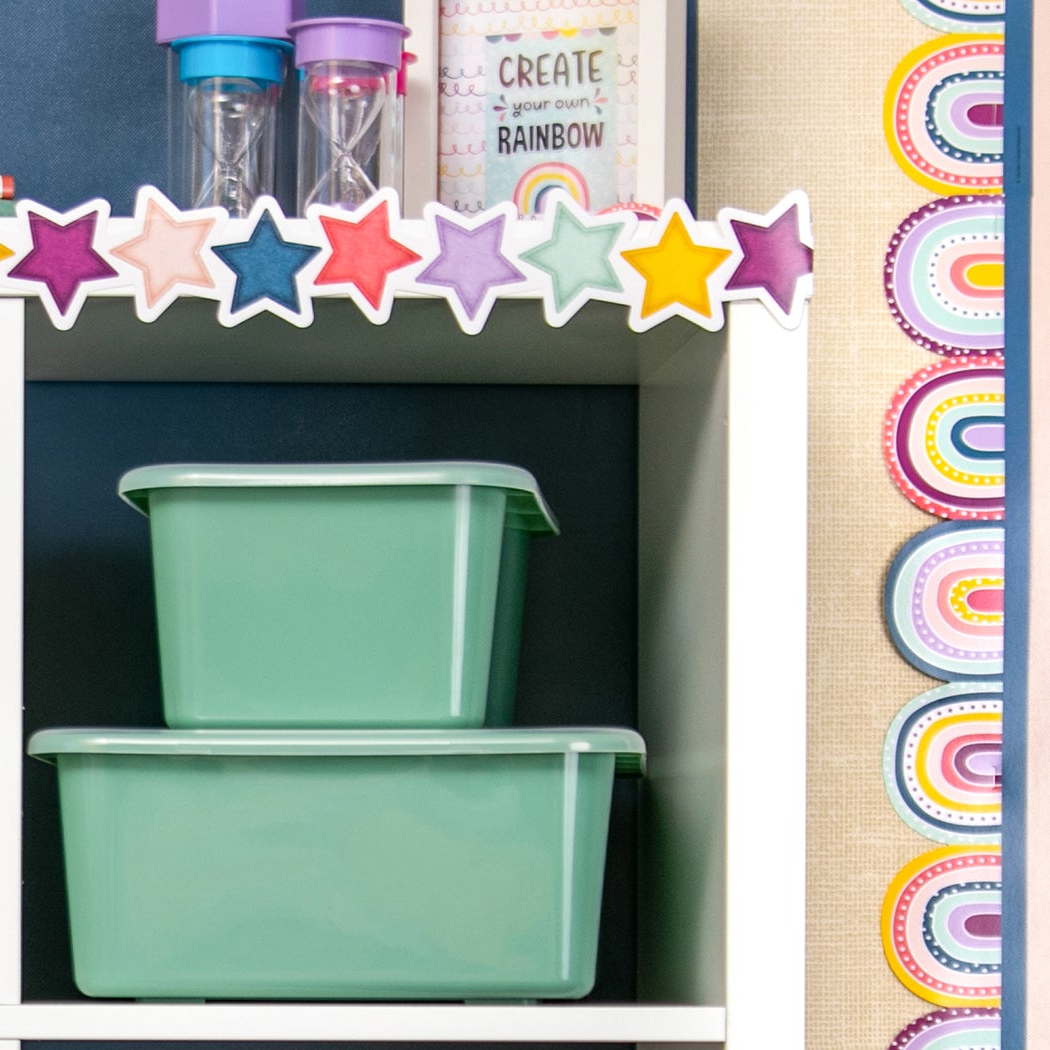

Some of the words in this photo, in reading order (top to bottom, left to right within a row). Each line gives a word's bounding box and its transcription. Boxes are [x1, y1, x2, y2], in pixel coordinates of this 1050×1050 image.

[499, 49, 603, 88] CREATE
[512, 100, 551, 118] your
[555, 97, 590, 109] own
[498, 122, 605, 155] RAINBOW
